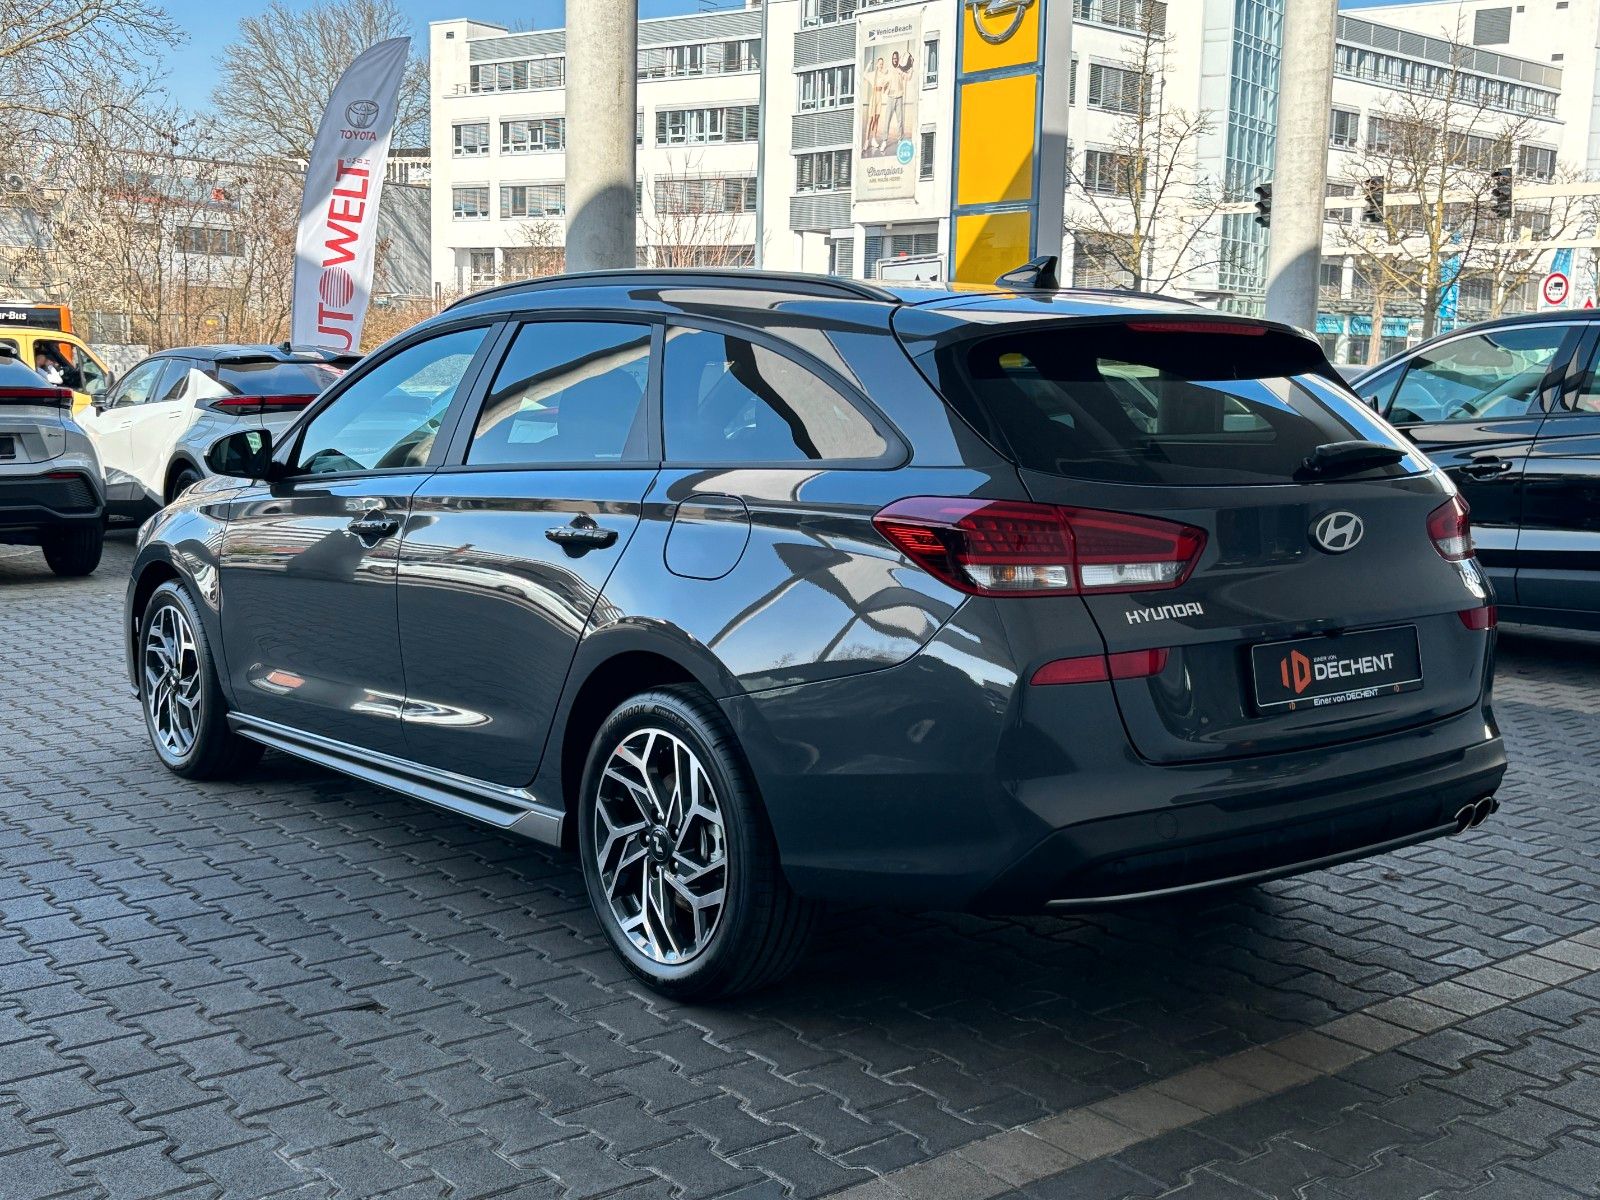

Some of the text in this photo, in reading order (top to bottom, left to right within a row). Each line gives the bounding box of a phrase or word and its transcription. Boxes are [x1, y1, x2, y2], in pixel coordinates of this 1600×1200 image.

[340, 129, 377, 141] TOYOTA
[317, 159, 371, 352] UTOWELT
[0, 310, 27, 320] r-Bus
[1125, 602, 1204, 625] HYUNDAI
[1313, 653, 1395, 681] DECHENT
[1313, 688, 1379, 706] Einer von DECHENT
